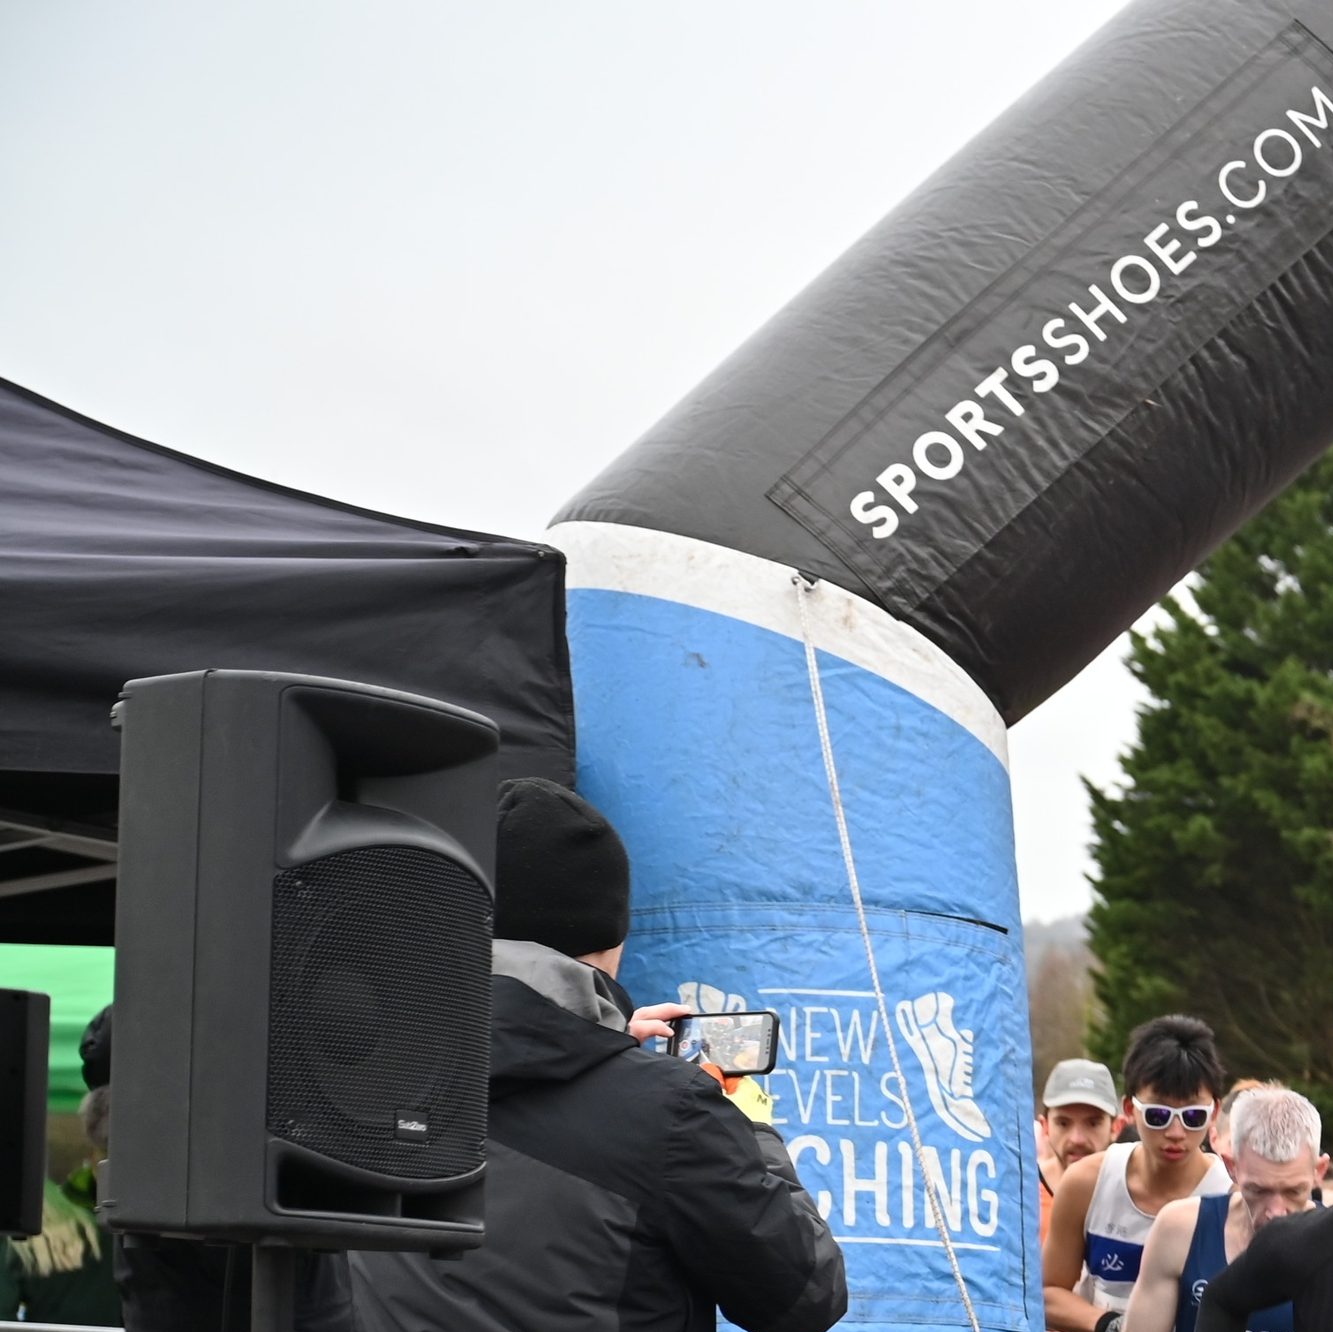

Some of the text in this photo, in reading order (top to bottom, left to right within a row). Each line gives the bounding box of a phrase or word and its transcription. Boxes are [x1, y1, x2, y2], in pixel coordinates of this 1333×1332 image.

[766, 1006, 878, 1065] NEW
[764, 1069, 910, 1129] EVELS
[786, 1134, 999, 1237] CHING
